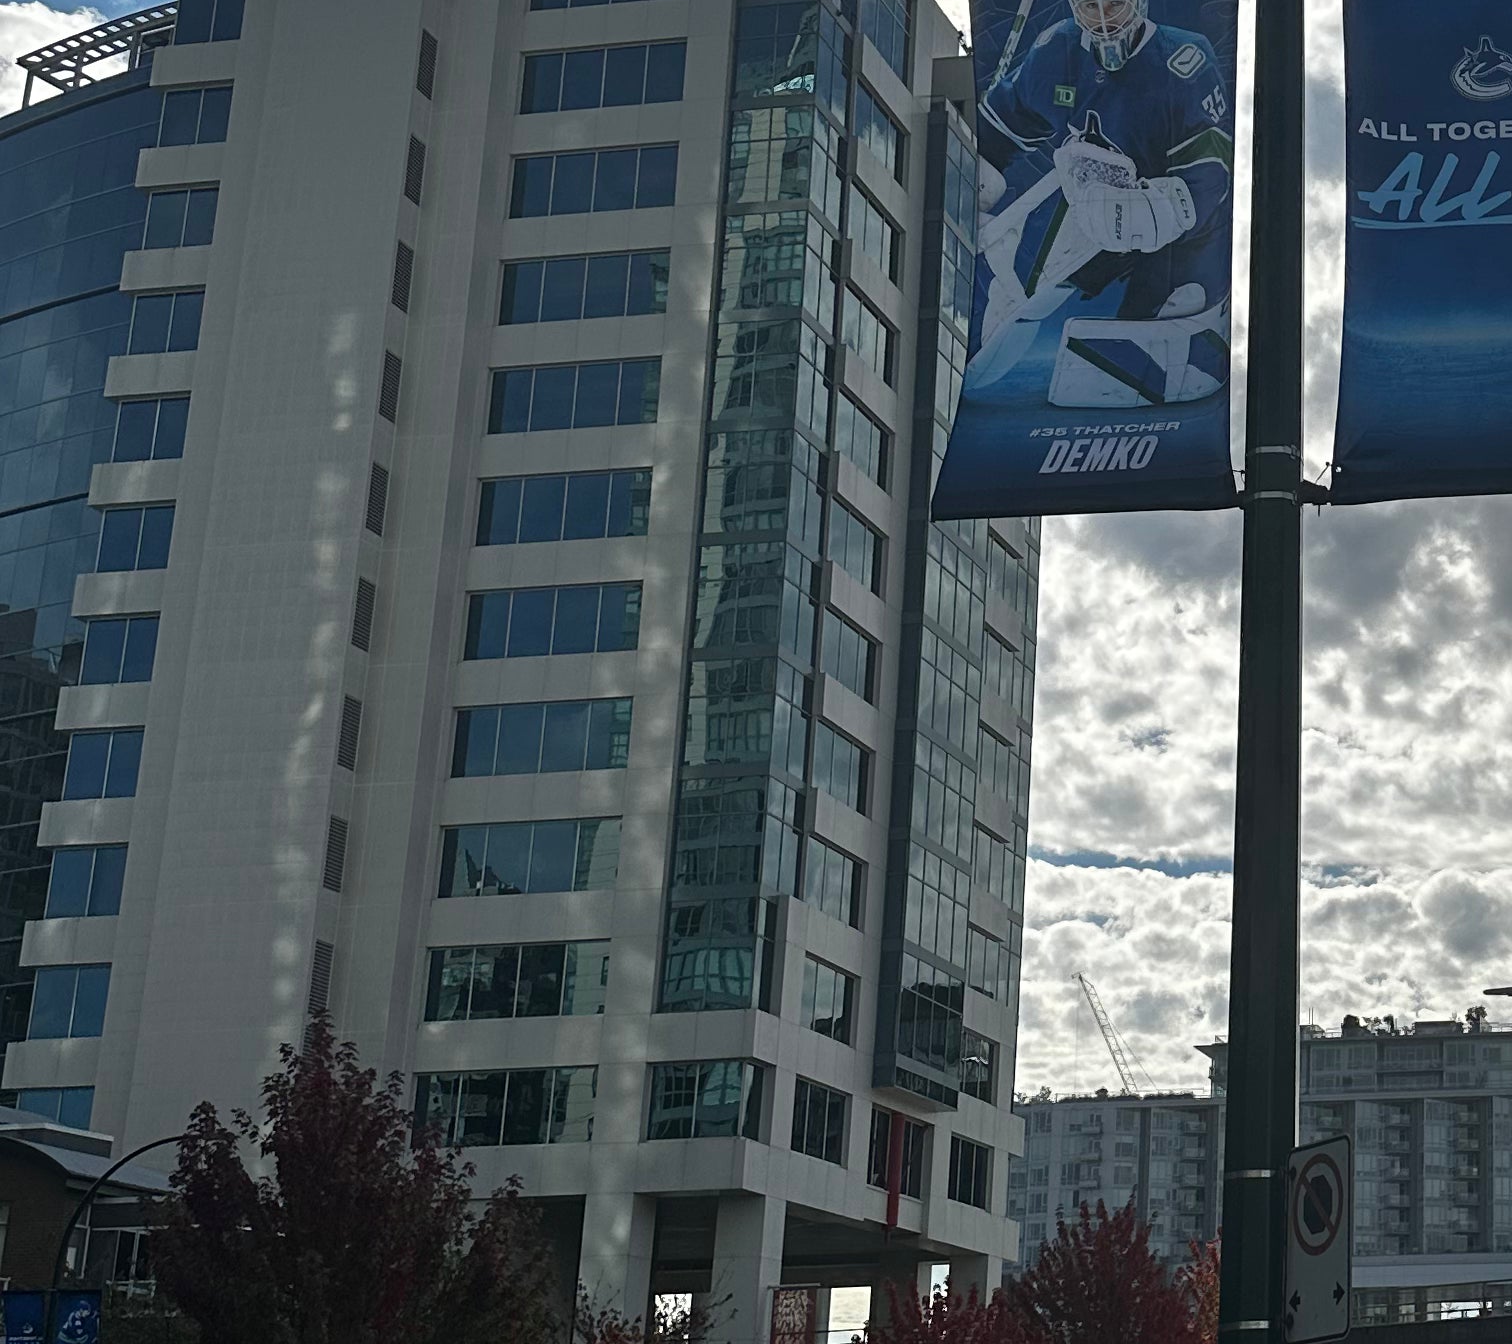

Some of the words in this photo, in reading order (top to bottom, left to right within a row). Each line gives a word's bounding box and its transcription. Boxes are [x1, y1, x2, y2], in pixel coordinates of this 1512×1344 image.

[1056, 87, 1074, 104] TD
[1202, 84, 1227, 123] 35
[1358, 116, 1418, 142] ALL
[1357, 150, 1512, 223] ALL
[1029, 426, 1067, 438] #35
[1073, 421, 1181, 436] THATCHER
[1038, 434, 1159, 474] DEMKO
